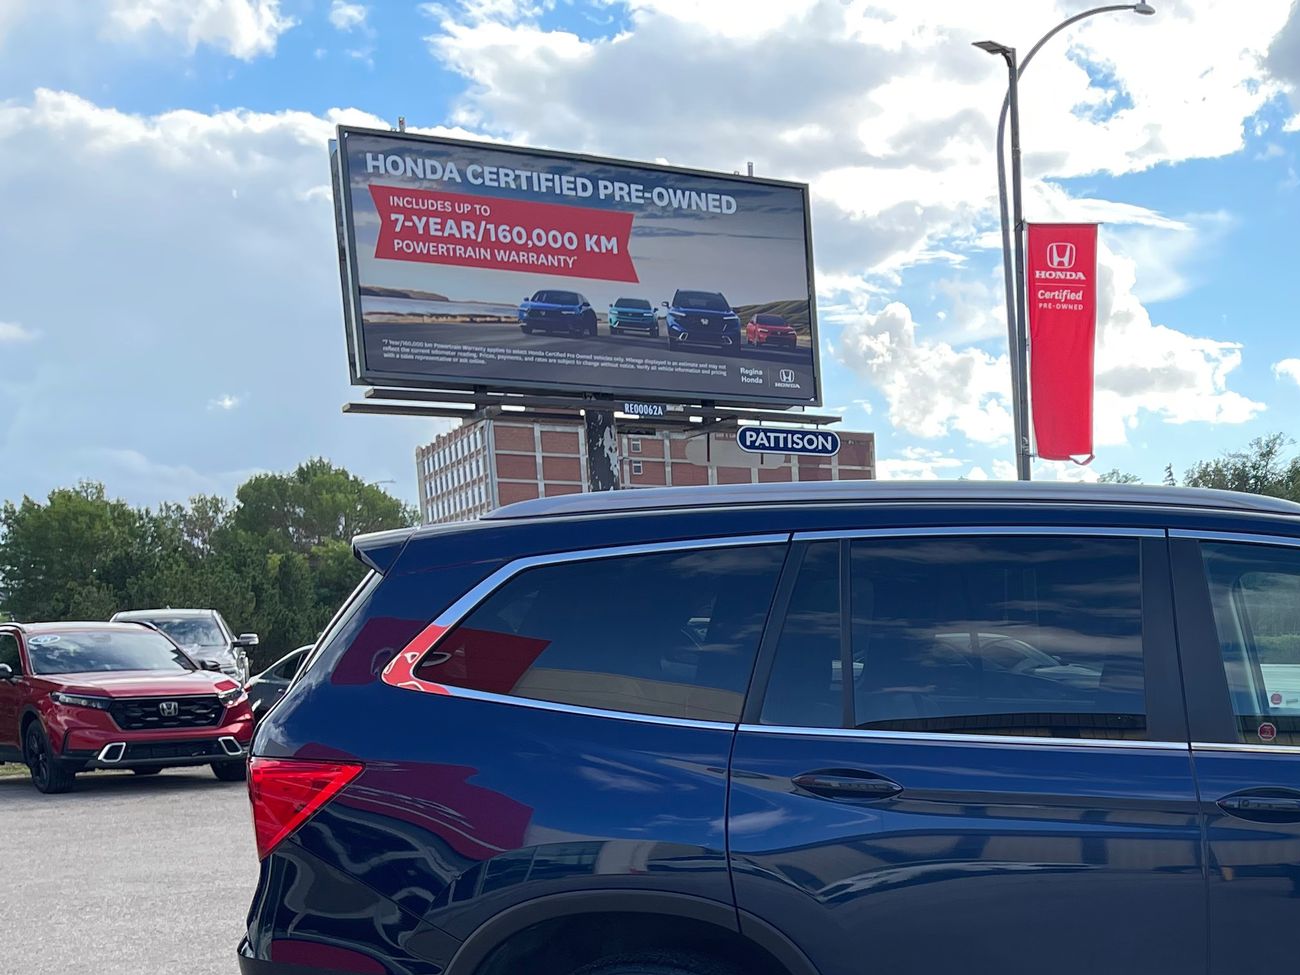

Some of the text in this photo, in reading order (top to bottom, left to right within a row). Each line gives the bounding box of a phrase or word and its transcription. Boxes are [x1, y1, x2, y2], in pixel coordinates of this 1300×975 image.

[366, 152, 736, 214] HONDA CERTIFIED PRE-OWNED
[390, 196, 490, 216] INCLUDES UP TO
[390, 214, 618, 254] 7-YEAR/160,000 KM
[394, 240, 491, 260] POWERTRAIN
[1035, 271, 1086, 280] HONDA
[1038, 290, 1083, 302] Certified
[740, 368, 762, 376] Regina
[742, 376, 762, 384] Honda
[624, 402, 663, 416] RE00062A
[746, 431, 832, 450] PATTISON
